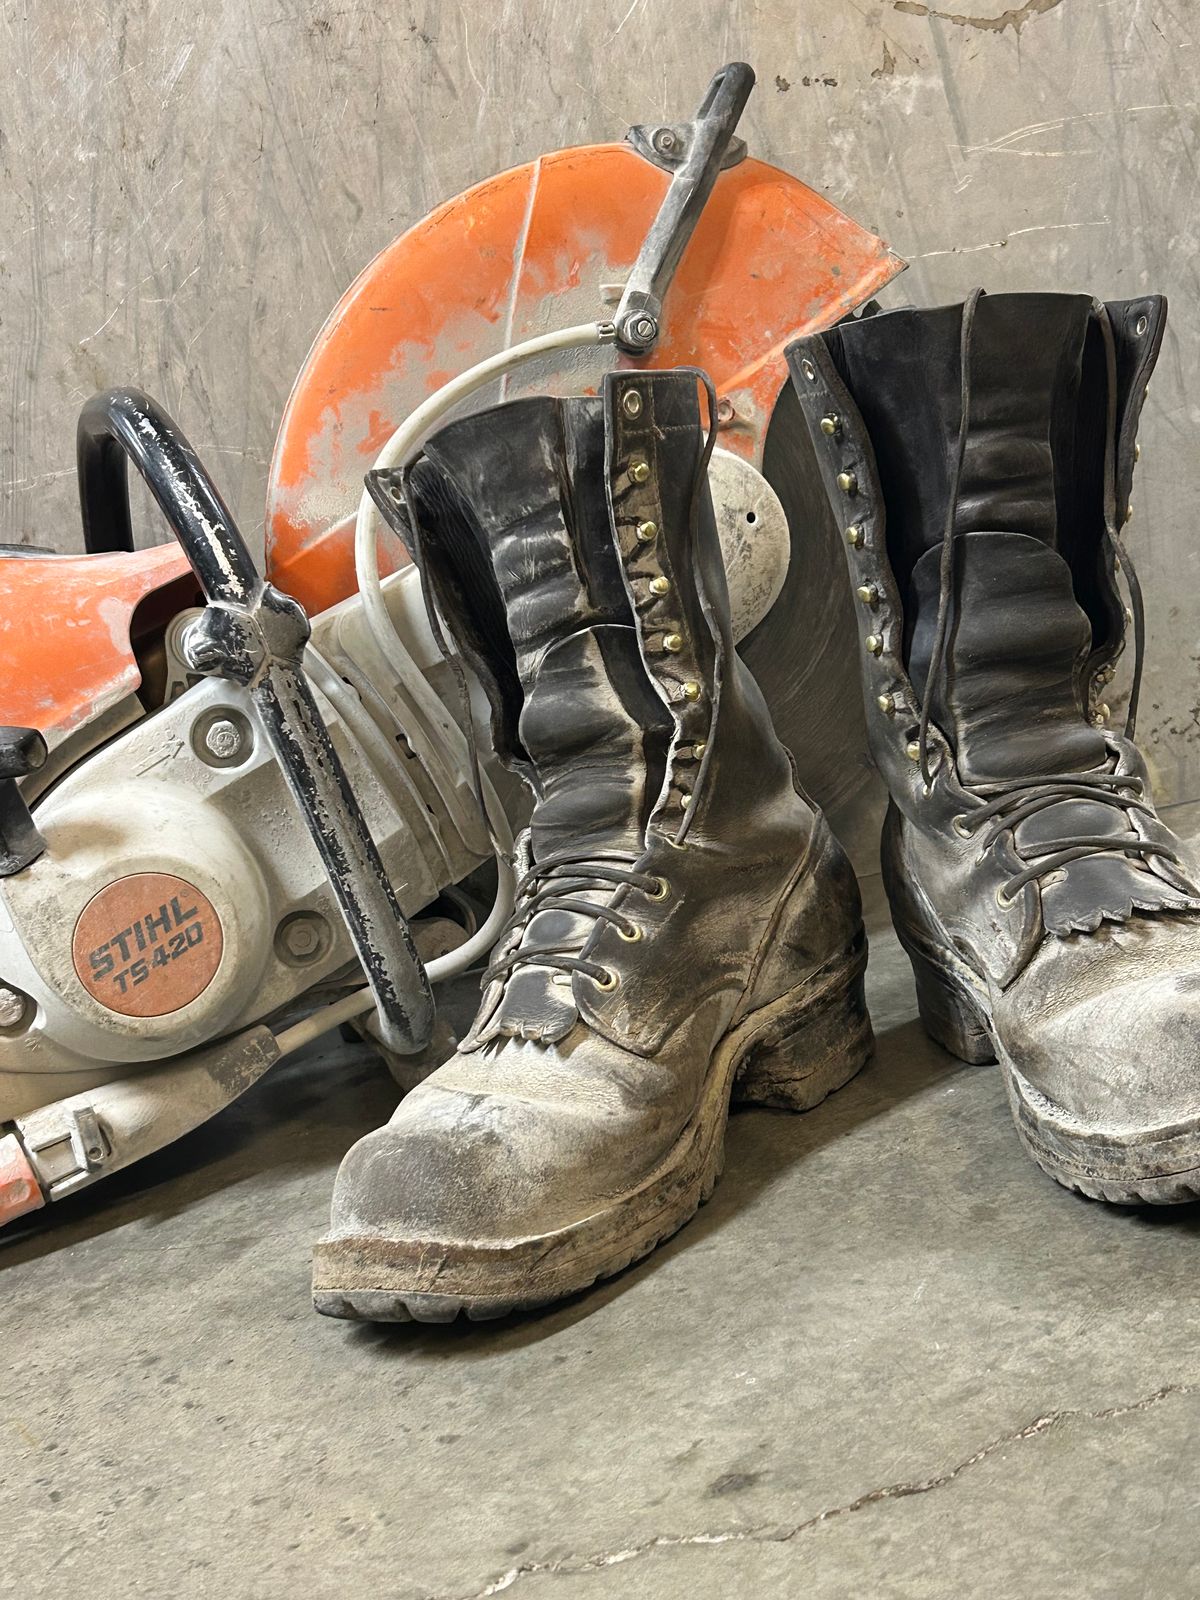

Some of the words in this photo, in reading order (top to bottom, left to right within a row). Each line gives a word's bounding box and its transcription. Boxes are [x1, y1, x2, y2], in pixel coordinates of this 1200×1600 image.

[89, 896, 198, 981] STIHL
[113, 957, 150, 993] TS
[152, 921, 204, 969] 420
